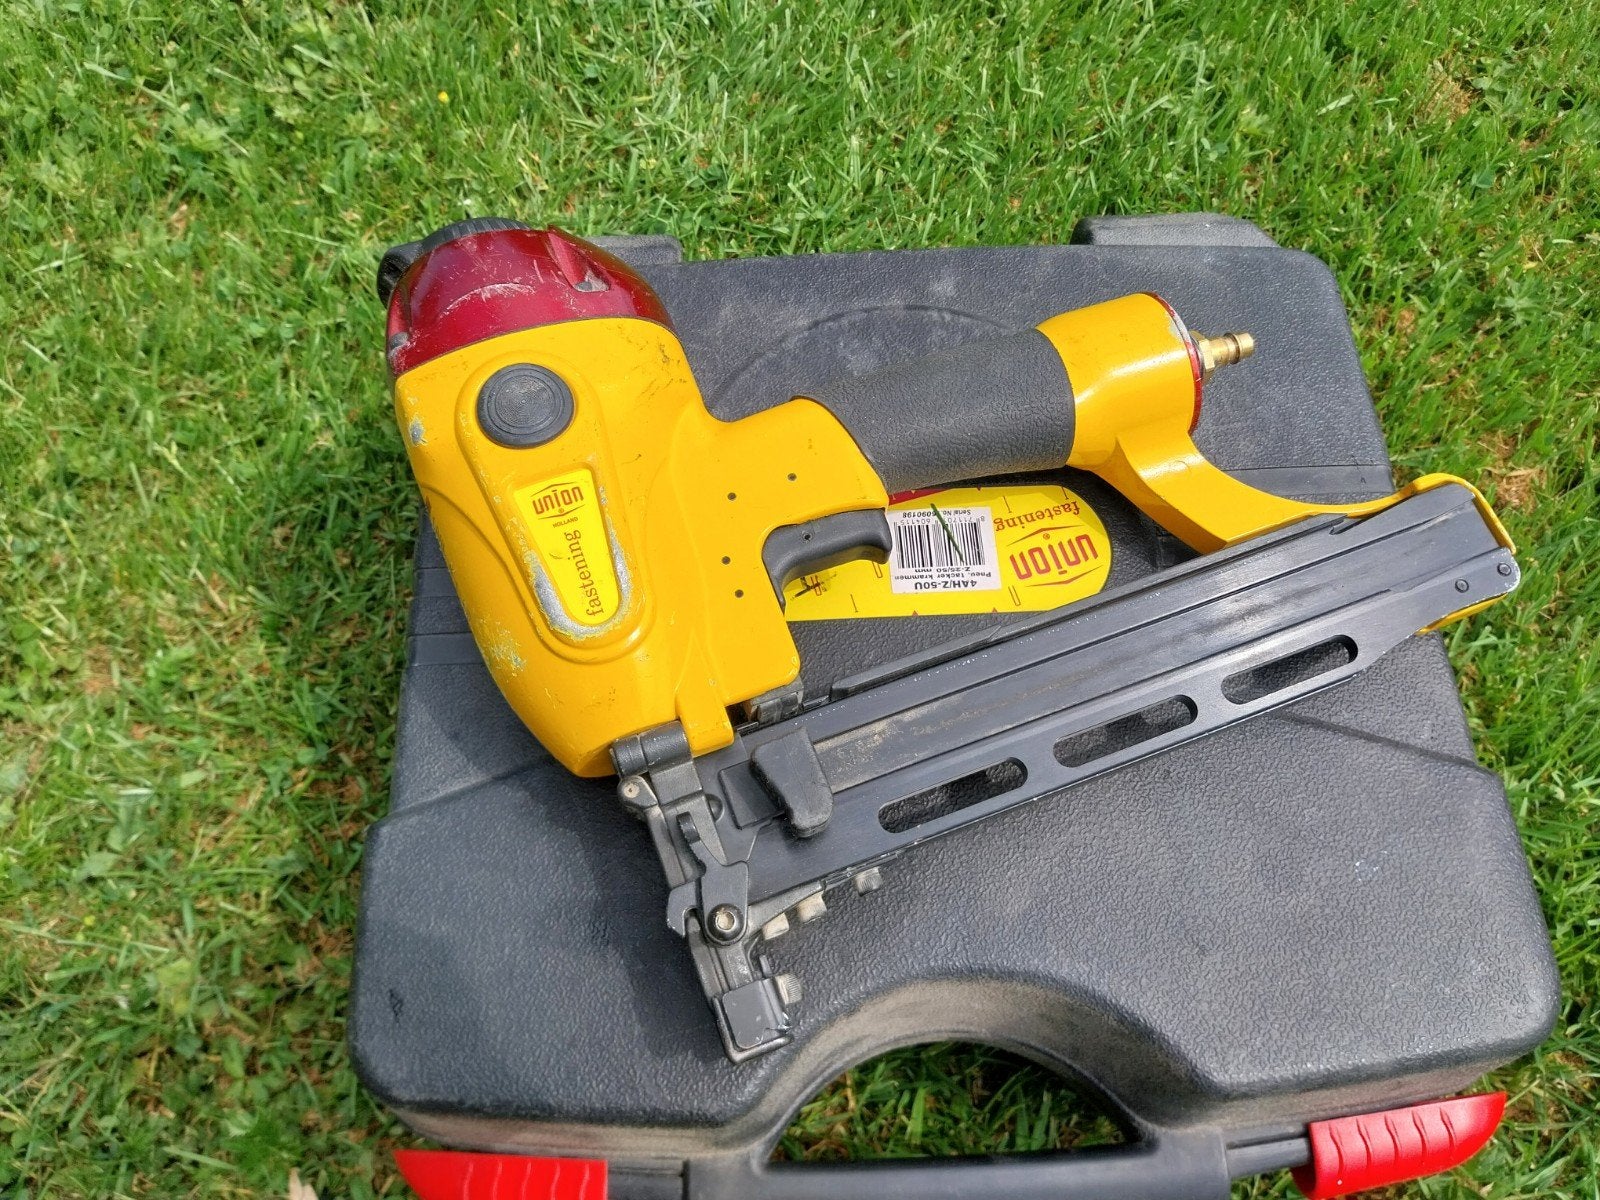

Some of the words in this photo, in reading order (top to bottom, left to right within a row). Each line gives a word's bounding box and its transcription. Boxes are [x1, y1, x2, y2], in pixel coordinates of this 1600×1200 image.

[552, 516, 579, 528] HOLLAND
[993, 501, 1080, 532] fastening
[564, 529, 604, 617] fastening
[914, 580, 977, 590] 4AH/Z-50U
